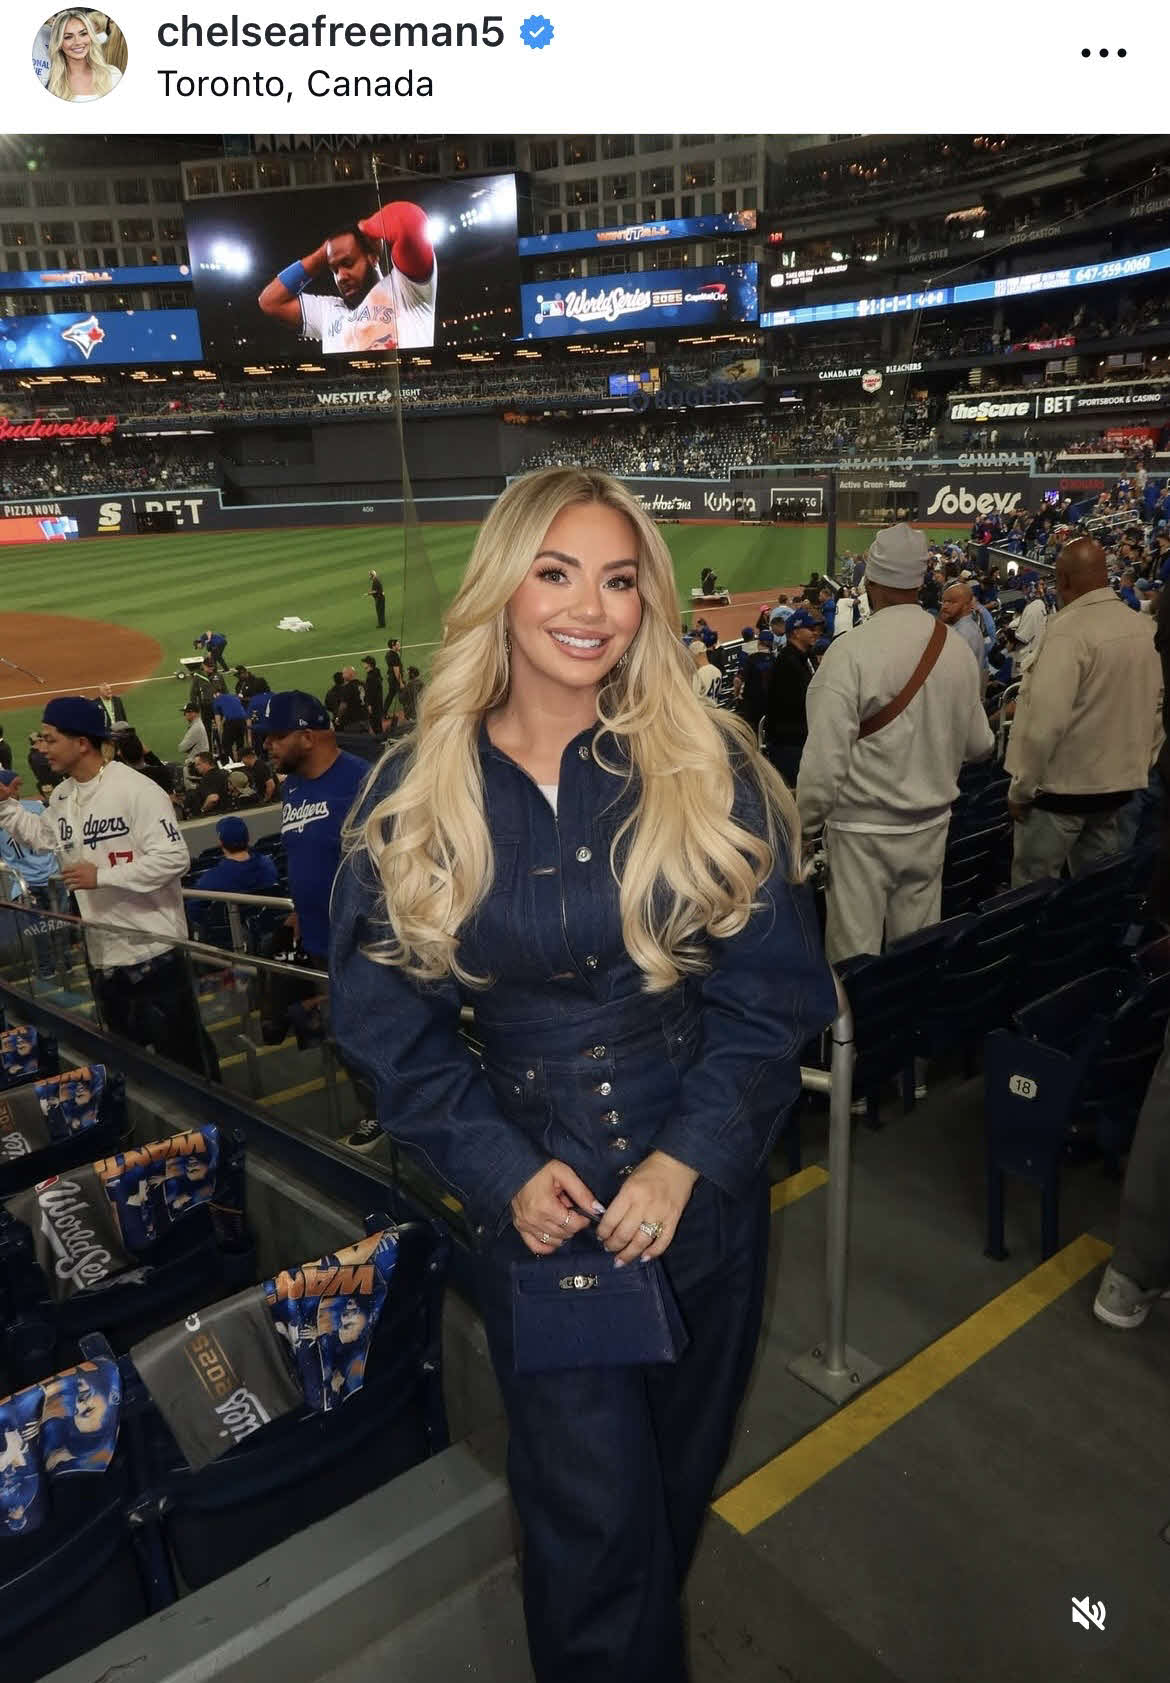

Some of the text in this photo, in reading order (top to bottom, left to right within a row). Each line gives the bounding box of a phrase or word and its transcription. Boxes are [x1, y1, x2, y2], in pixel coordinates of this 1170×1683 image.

[819, 368, 862, 379] CANADA DRY
[886, 363, 922, 374] BLEACHERS
[394, 387, 422, 399] LIGHT
[951, 401, 1030, 420] theScore
[1044, 396, 1076, 414] BET
[1078, 396, 1126, 407] SPORTSBOOK
[1133, 394, 1161, 404] CASINO
[840, 456, 913, 471] BLEACHRS
[840, 480, 860, 489] Active
[652, 494, 691, 510] Hortons
[927, 485, 1022, 515] Sobeys
[4, 503, 62, 517] PIZZA NOVA
[99, 502, 123, 526] S
[282, 799, 330, 834] Dodgers
[1015, 1079, 1031, 1094] 18
[38, 1180, 96, 1259] World
